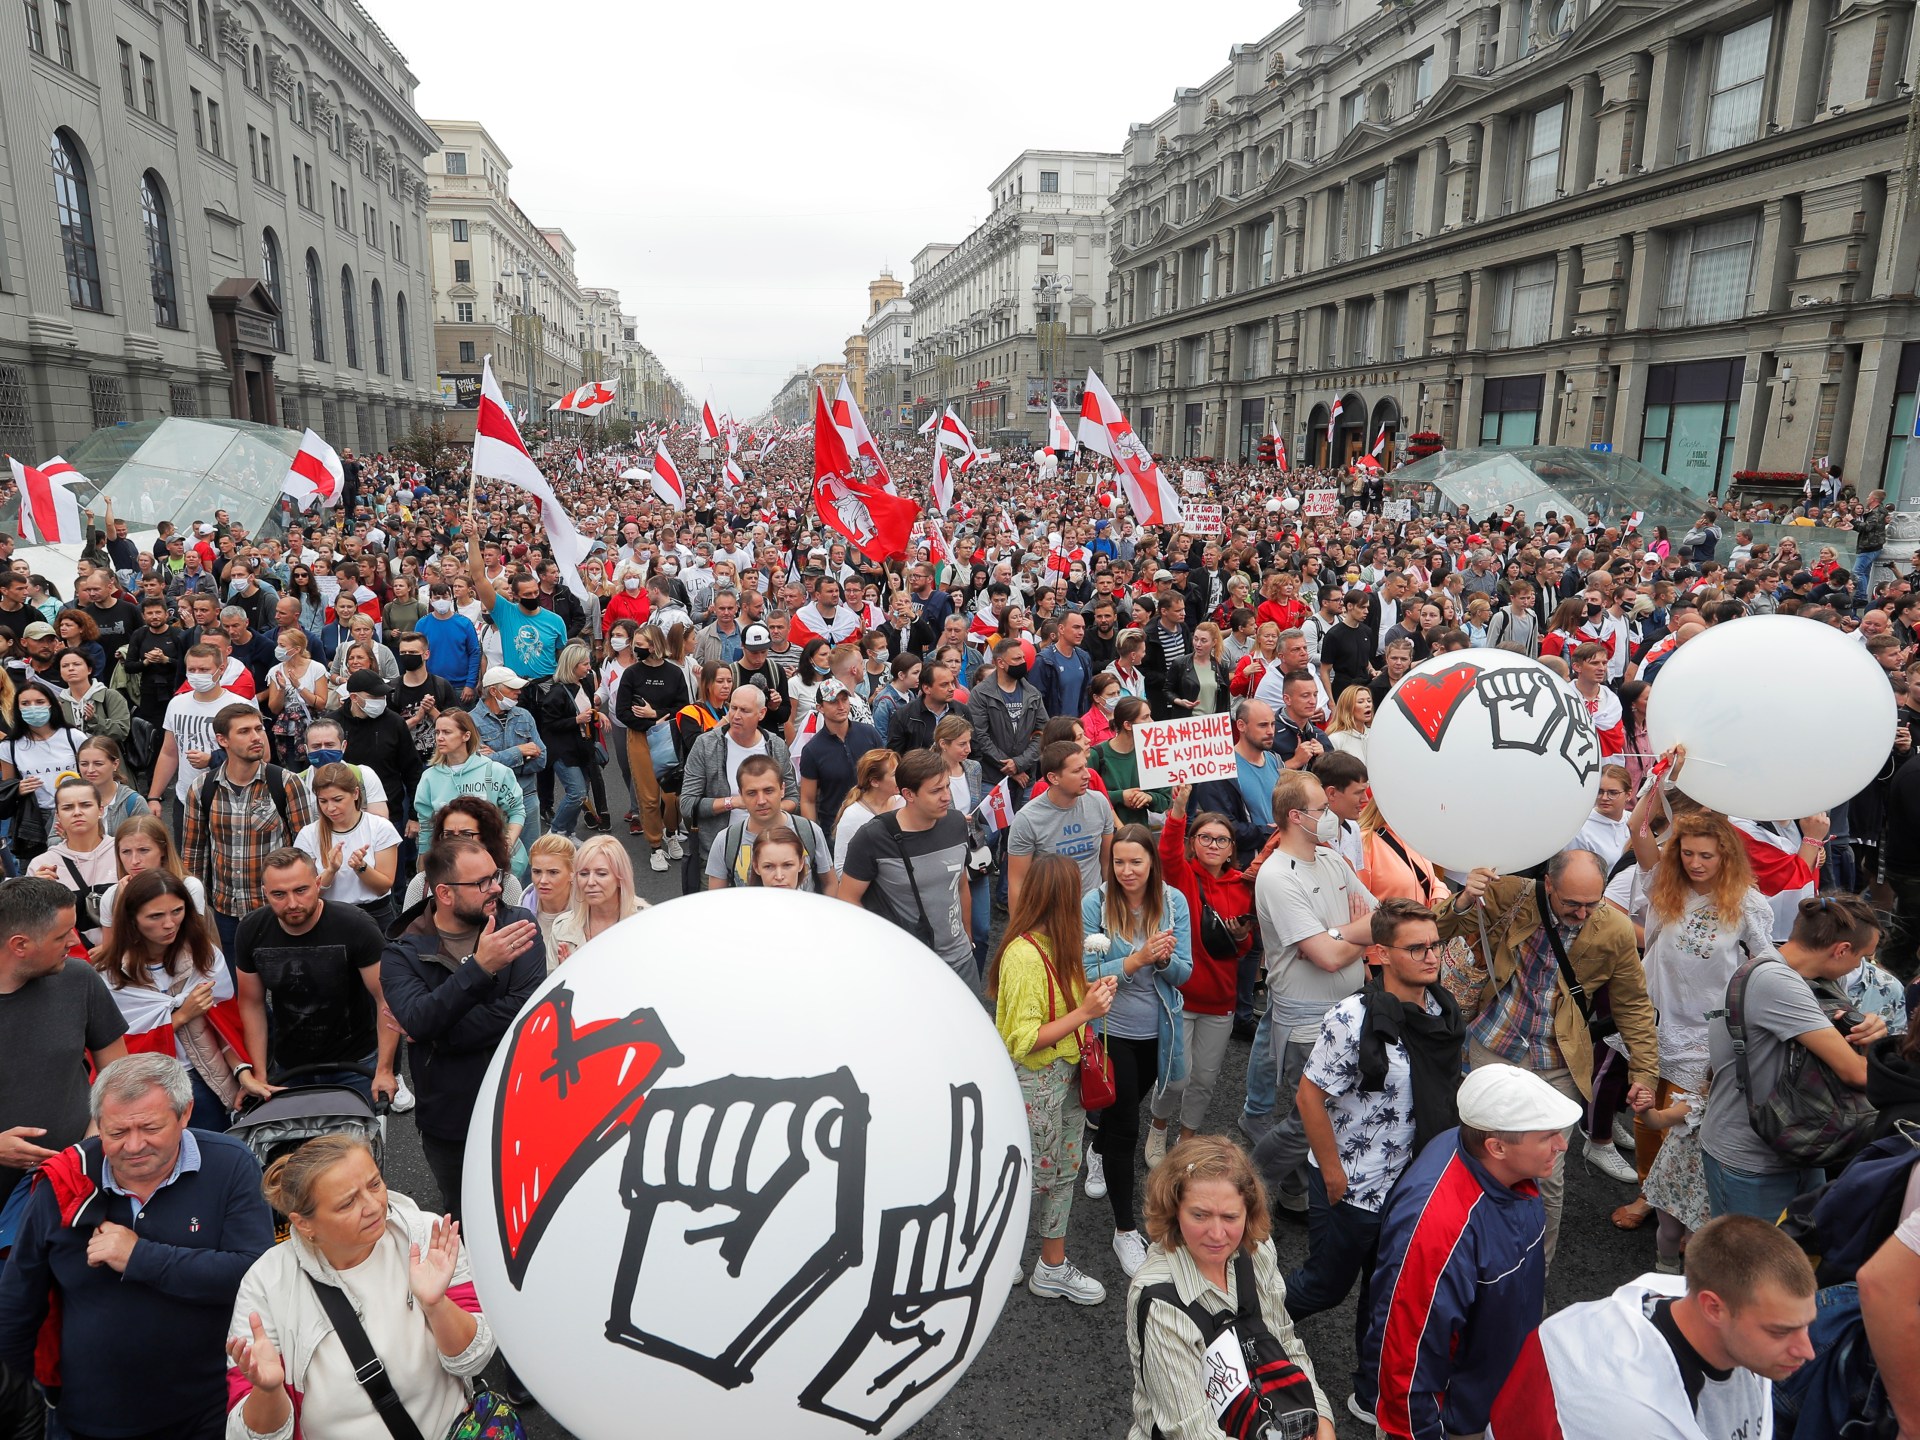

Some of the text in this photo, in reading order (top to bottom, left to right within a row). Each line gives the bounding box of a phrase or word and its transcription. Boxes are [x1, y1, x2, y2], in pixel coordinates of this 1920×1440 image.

[456, 378, 476, 386] SMILE
[1141, 716, 1232, 747] УВАЖЕНИЕ
[1143, 740, 1233, 769] НЕ КУПИШЬ
[26, 764, 76, 775] ALANC
[1168, 769, 1187, 782] ЗА
[1189, 761, 1216, 776] 100
[1063, 823, 1081, 836] NO
[1056, 841, 1094, 856] MORE
